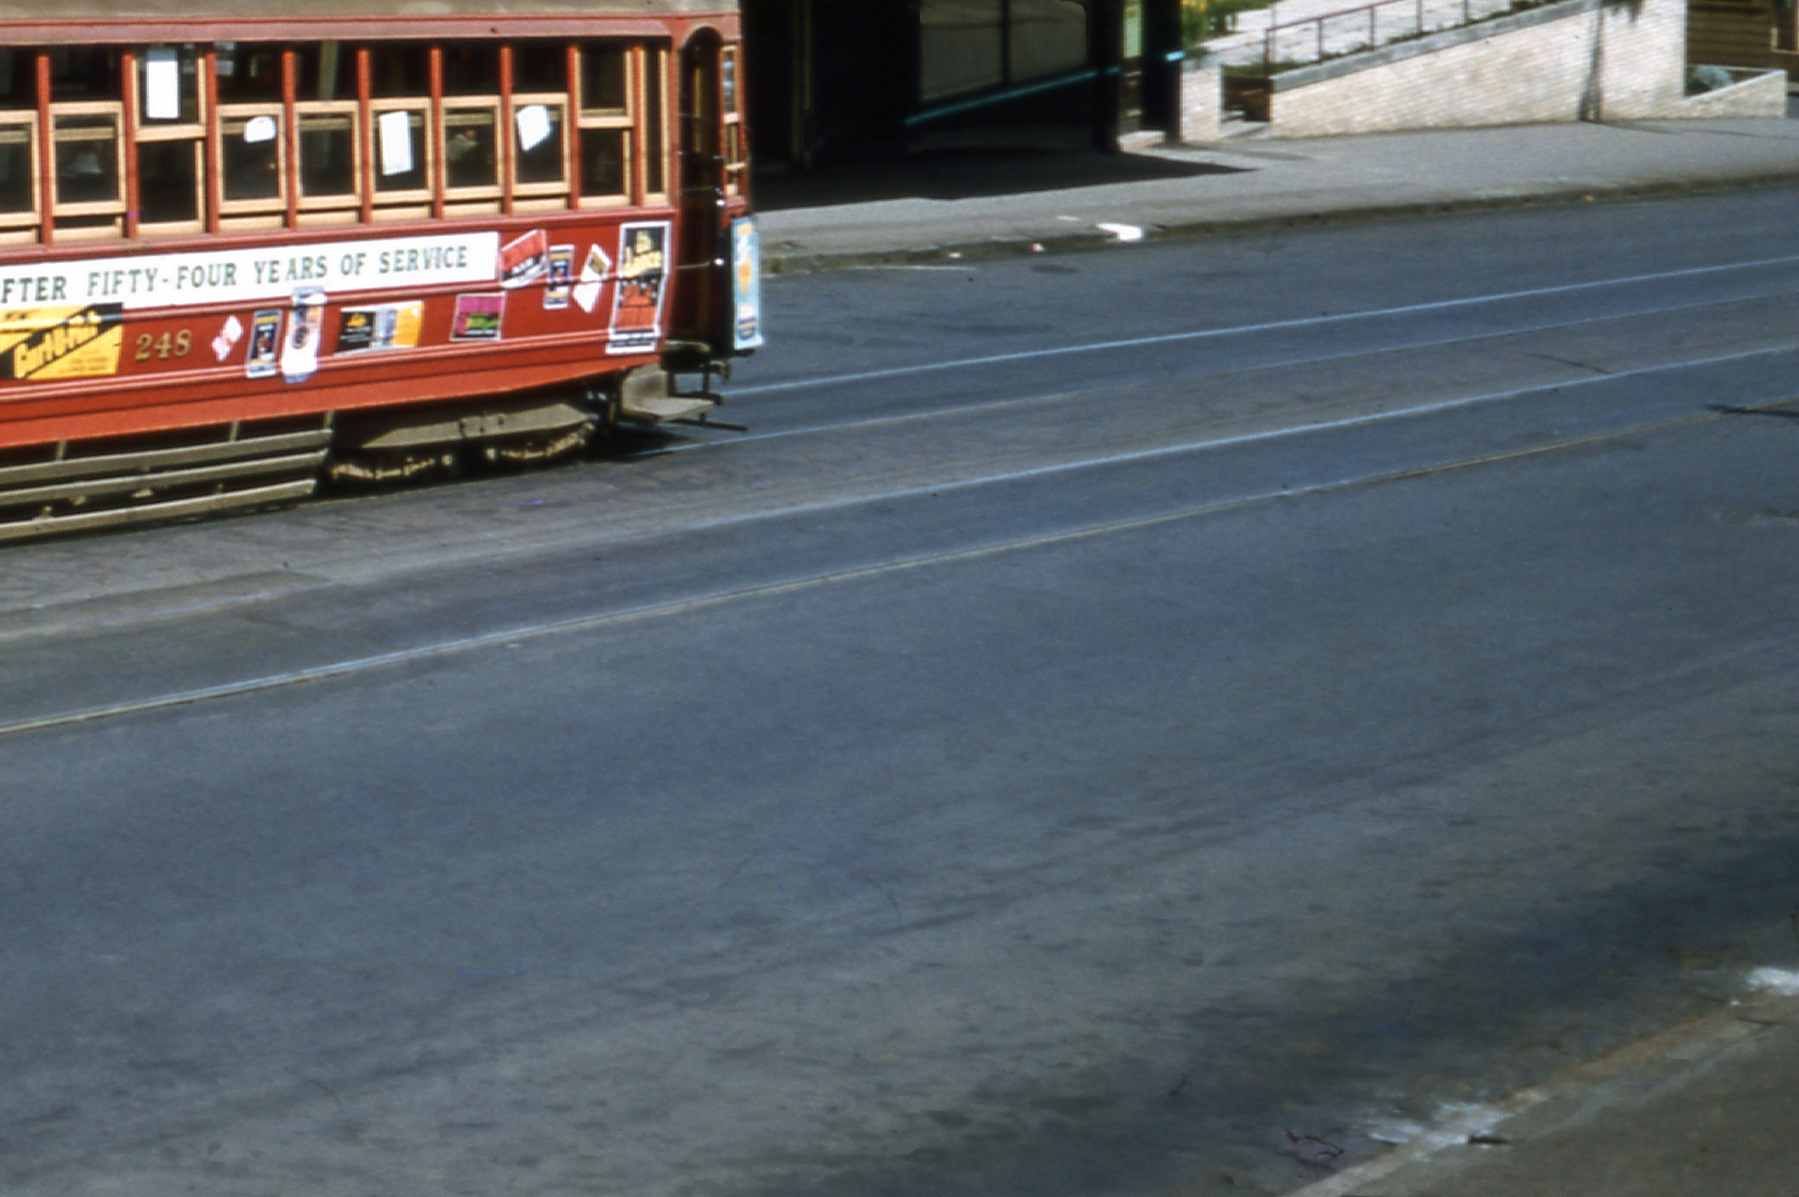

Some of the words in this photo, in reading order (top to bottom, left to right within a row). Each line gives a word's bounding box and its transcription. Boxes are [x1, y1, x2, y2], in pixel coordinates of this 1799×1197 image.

[86, 261, 238, 297] FIFTY-FOUR
[254, 254, 328, 286] YEARS
[340, 253, 367, 276] OF
[379, 245, 468, 275] SERVICE
[135, 329, 192, 363] 248
